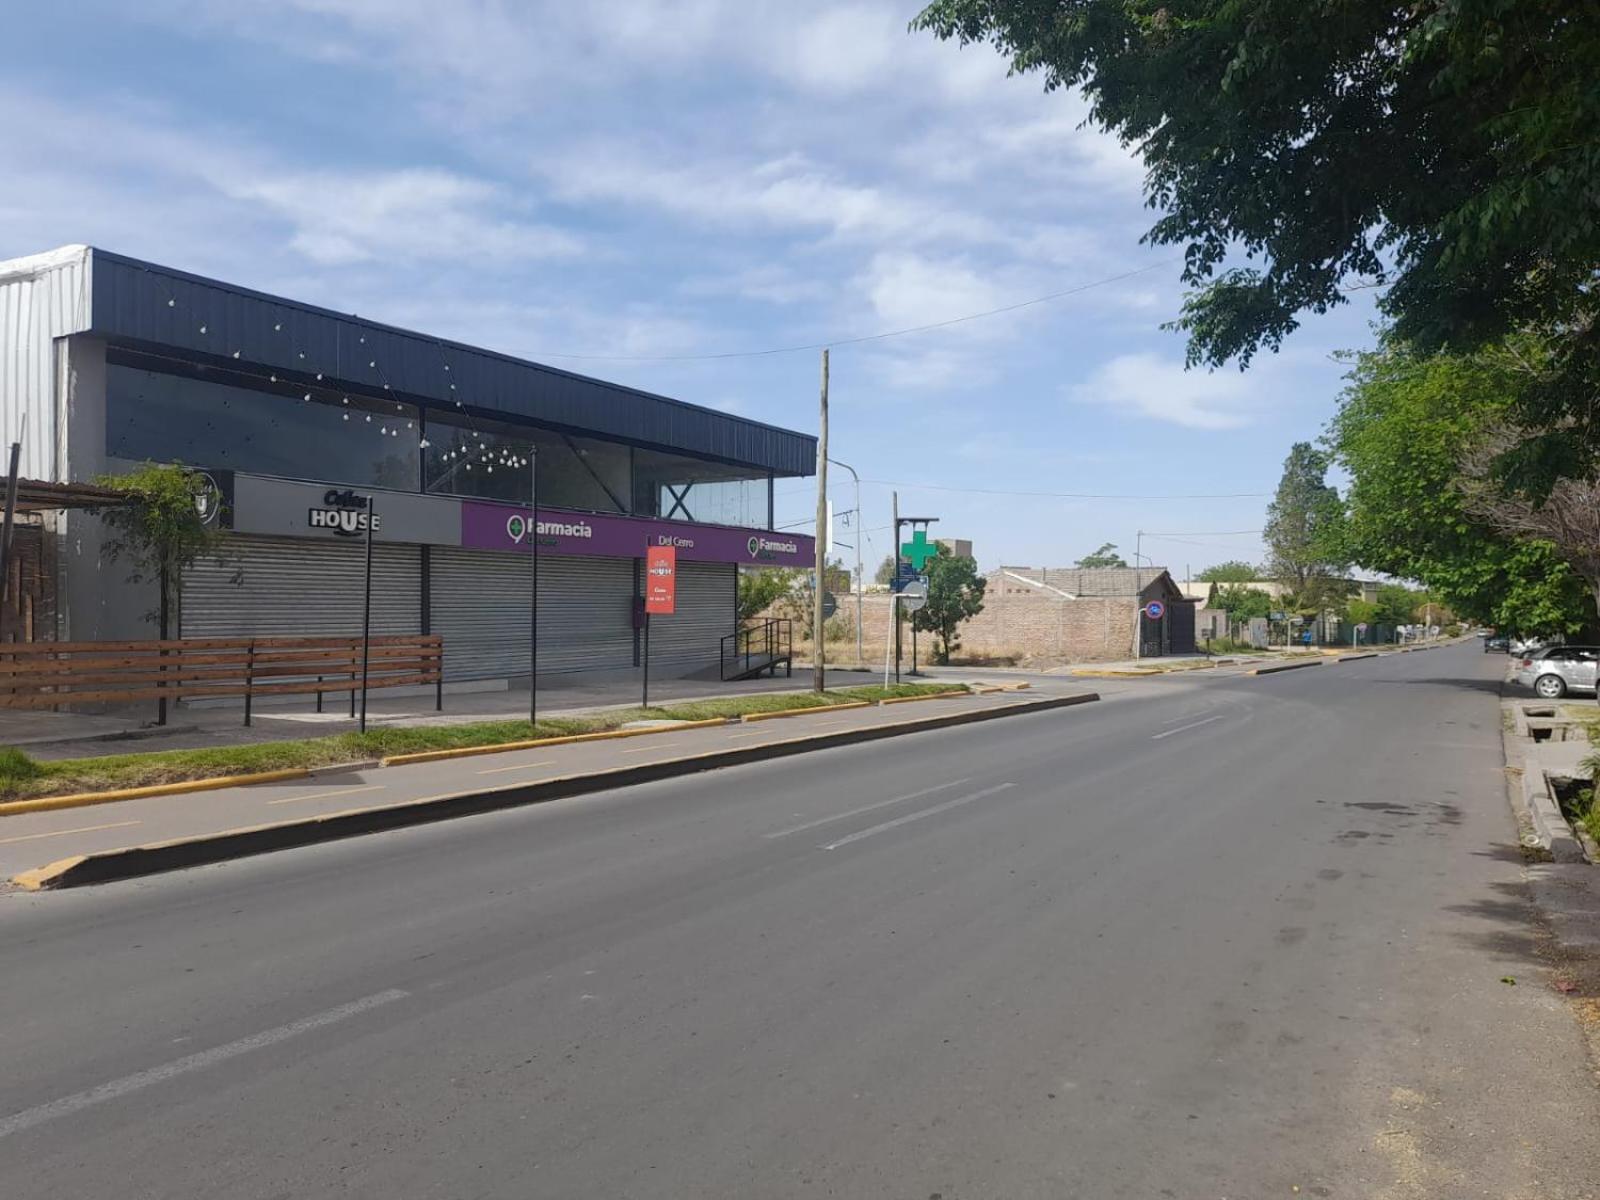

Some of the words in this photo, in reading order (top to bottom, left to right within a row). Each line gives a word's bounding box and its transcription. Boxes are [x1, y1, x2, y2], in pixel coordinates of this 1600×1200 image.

[311, 510, 381, 531] HOUSE
[527, 518, 592, 538] Farmacia
[760, 538, 797, 554] Farmacia
